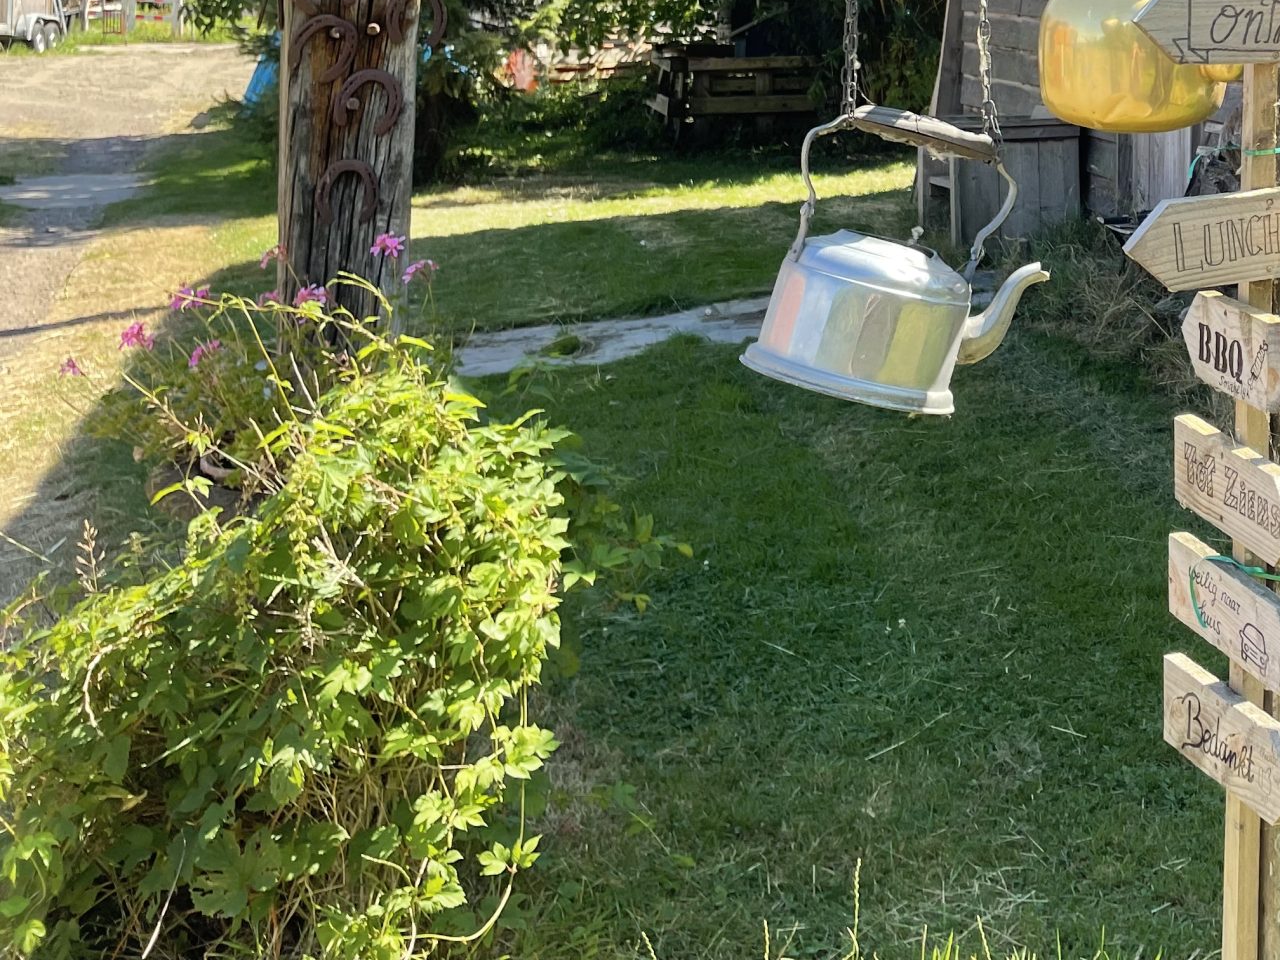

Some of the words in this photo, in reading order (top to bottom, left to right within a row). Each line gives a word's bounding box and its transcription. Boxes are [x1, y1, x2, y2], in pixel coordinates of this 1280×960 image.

[1198, 322, 1243, 384] BBQ
[1198, 600, 1222, 635] huis
[1220, 592, 1241, 615] naar
[1181, 691, 1255, 783] Bedankt
